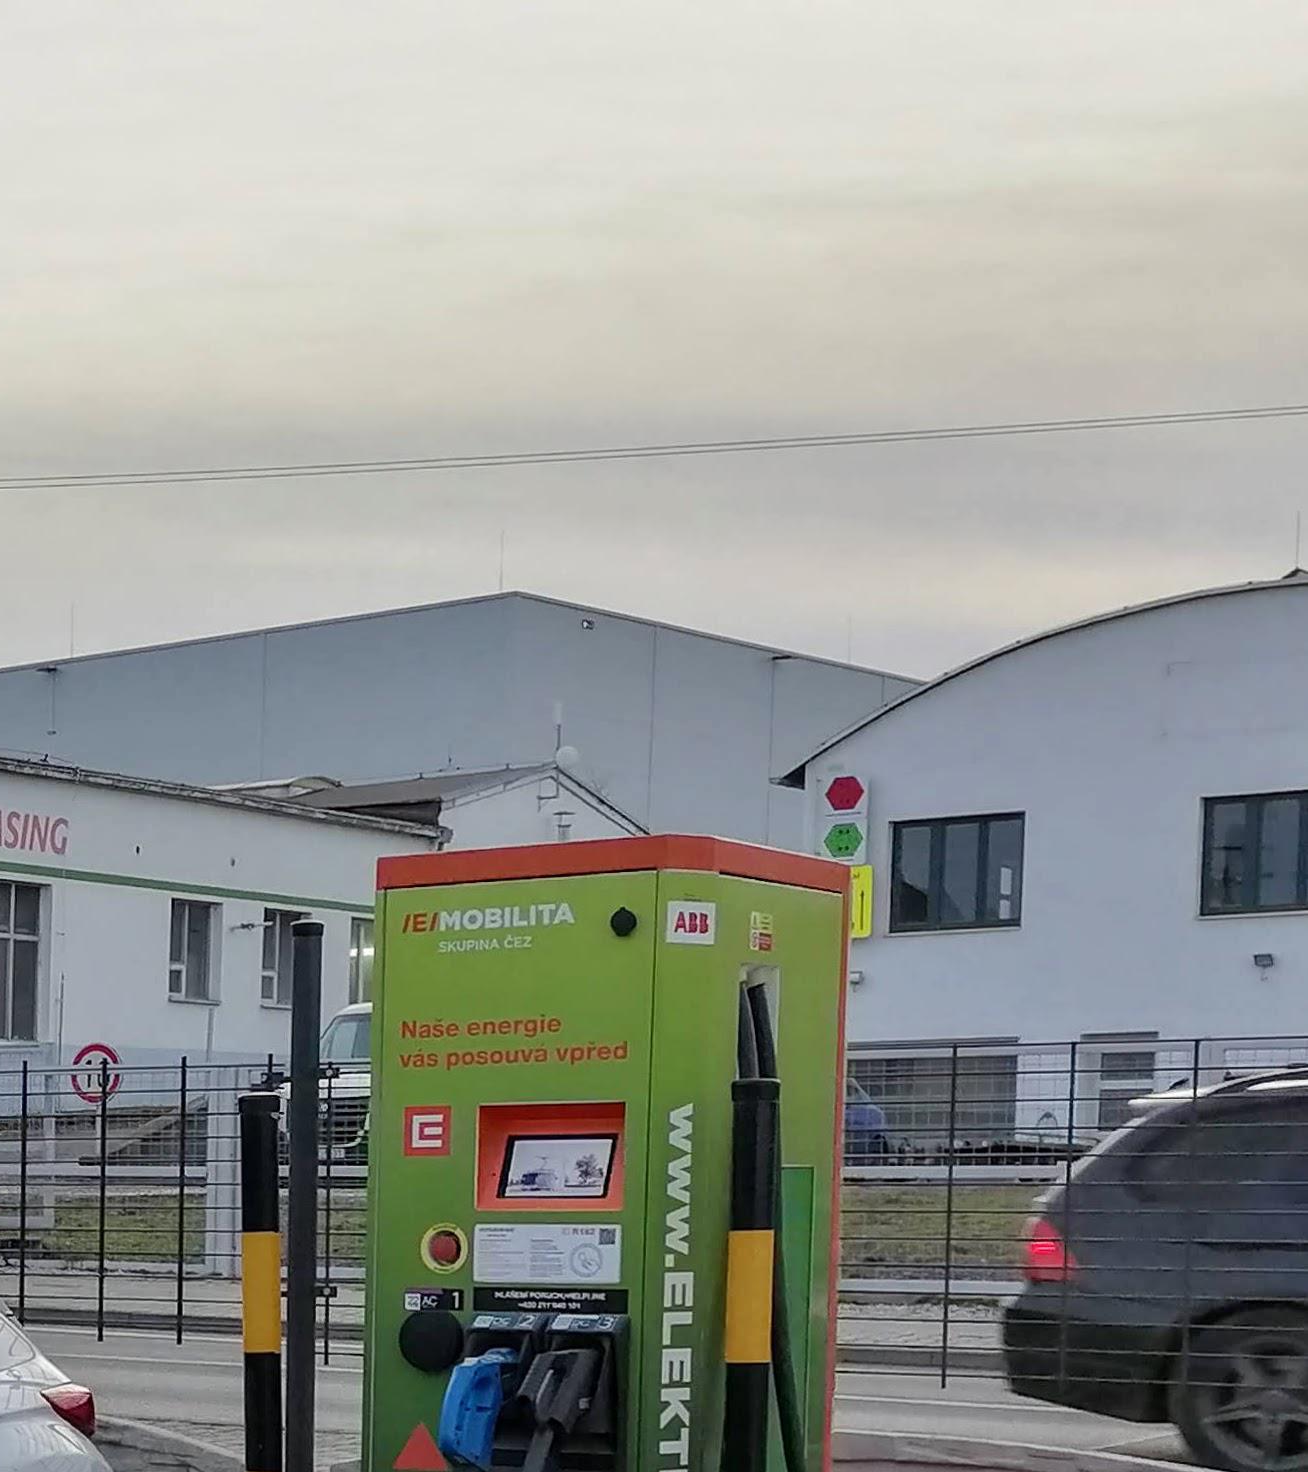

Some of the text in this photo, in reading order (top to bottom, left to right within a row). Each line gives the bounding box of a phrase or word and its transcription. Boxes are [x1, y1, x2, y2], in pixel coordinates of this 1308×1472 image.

[674, 911, 709, 934] ABB
[438, 935, 532, 953] SKUPINA ČEZ
[401, 1014, 562, 1039] Naše energie
[399, 1041, 629, 1071] vás posouvá vpřed
[452, 1291, 460, 1309] 1
[520, 1315, 535, 1327] 2
[599, 1317, 614, 1329] 3
